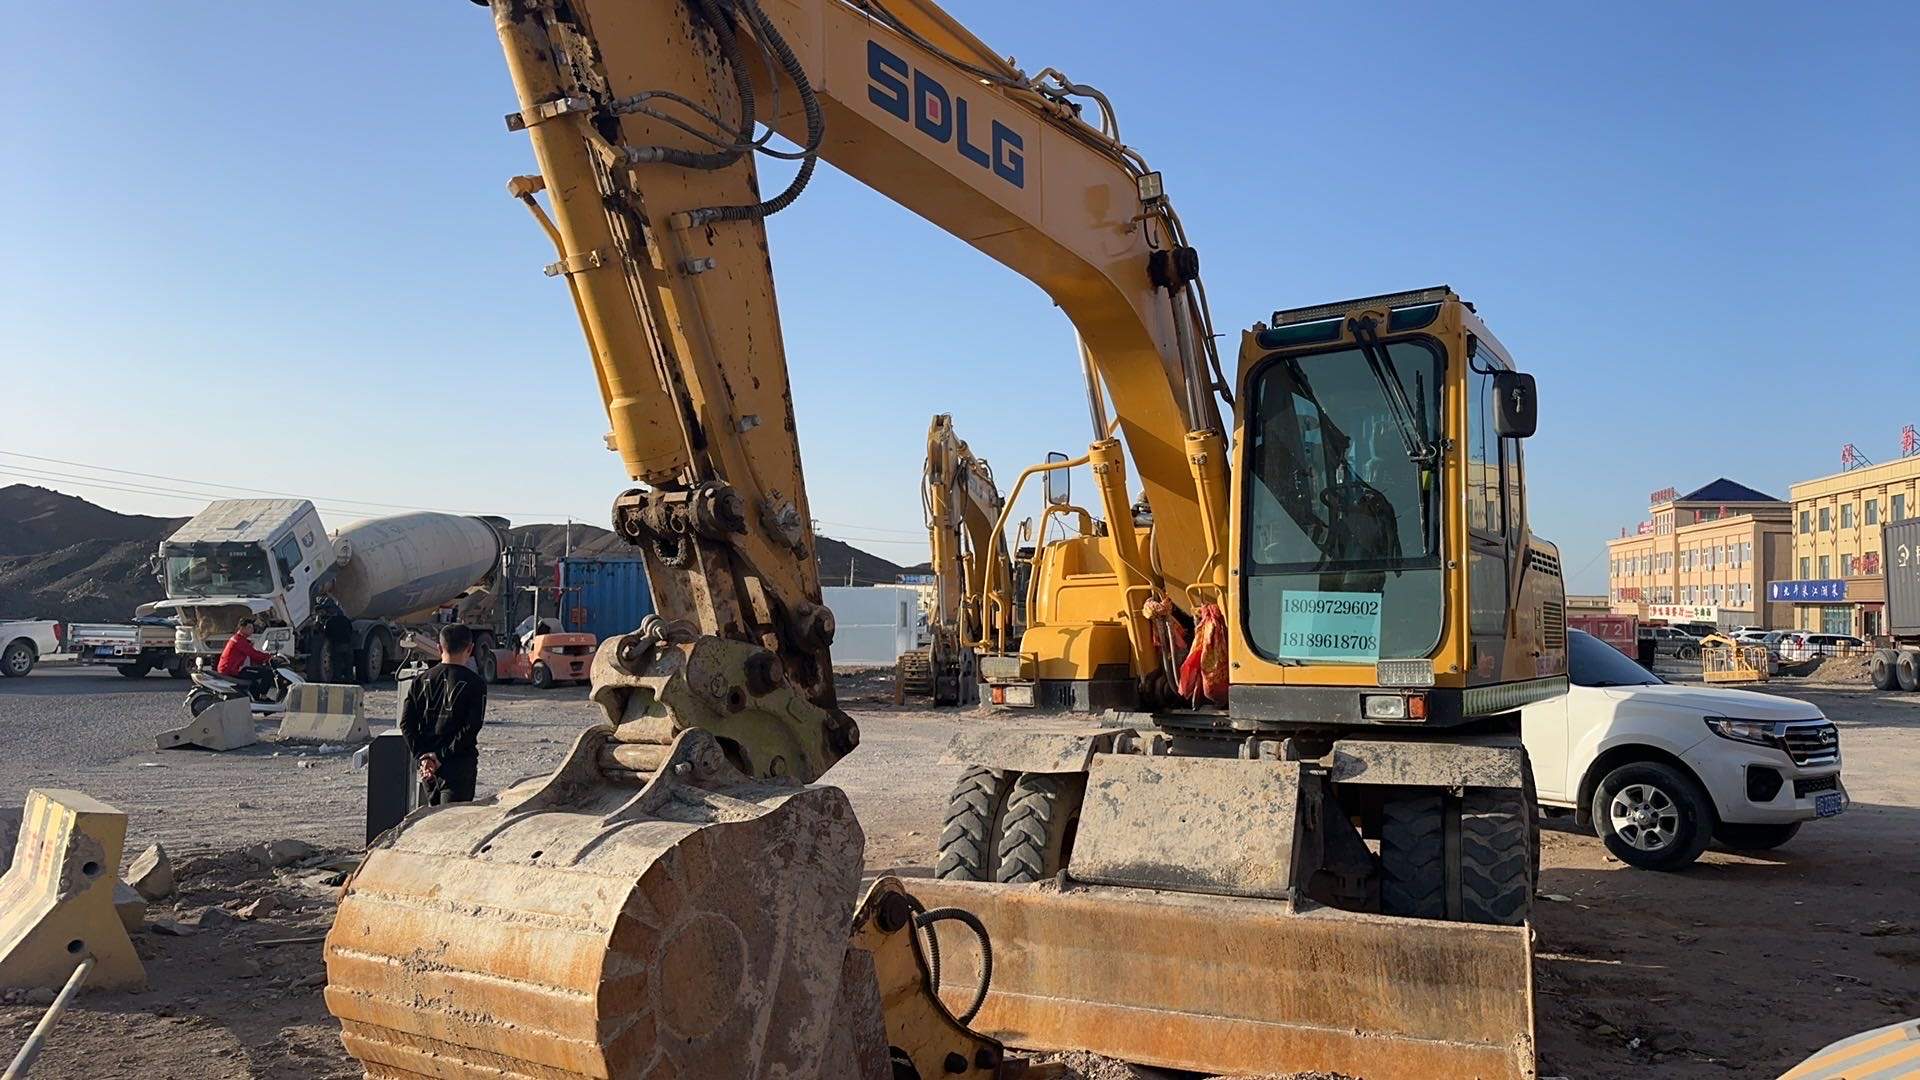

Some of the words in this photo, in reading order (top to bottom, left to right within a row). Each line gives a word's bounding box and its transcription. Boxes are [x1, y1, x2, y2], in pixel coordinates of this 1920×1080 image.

[867, 39, 1025, 189] SDLG
[1284, 599, 1378, 615] 18099729602
[1283, 632, 1377, 651] 18189618708
